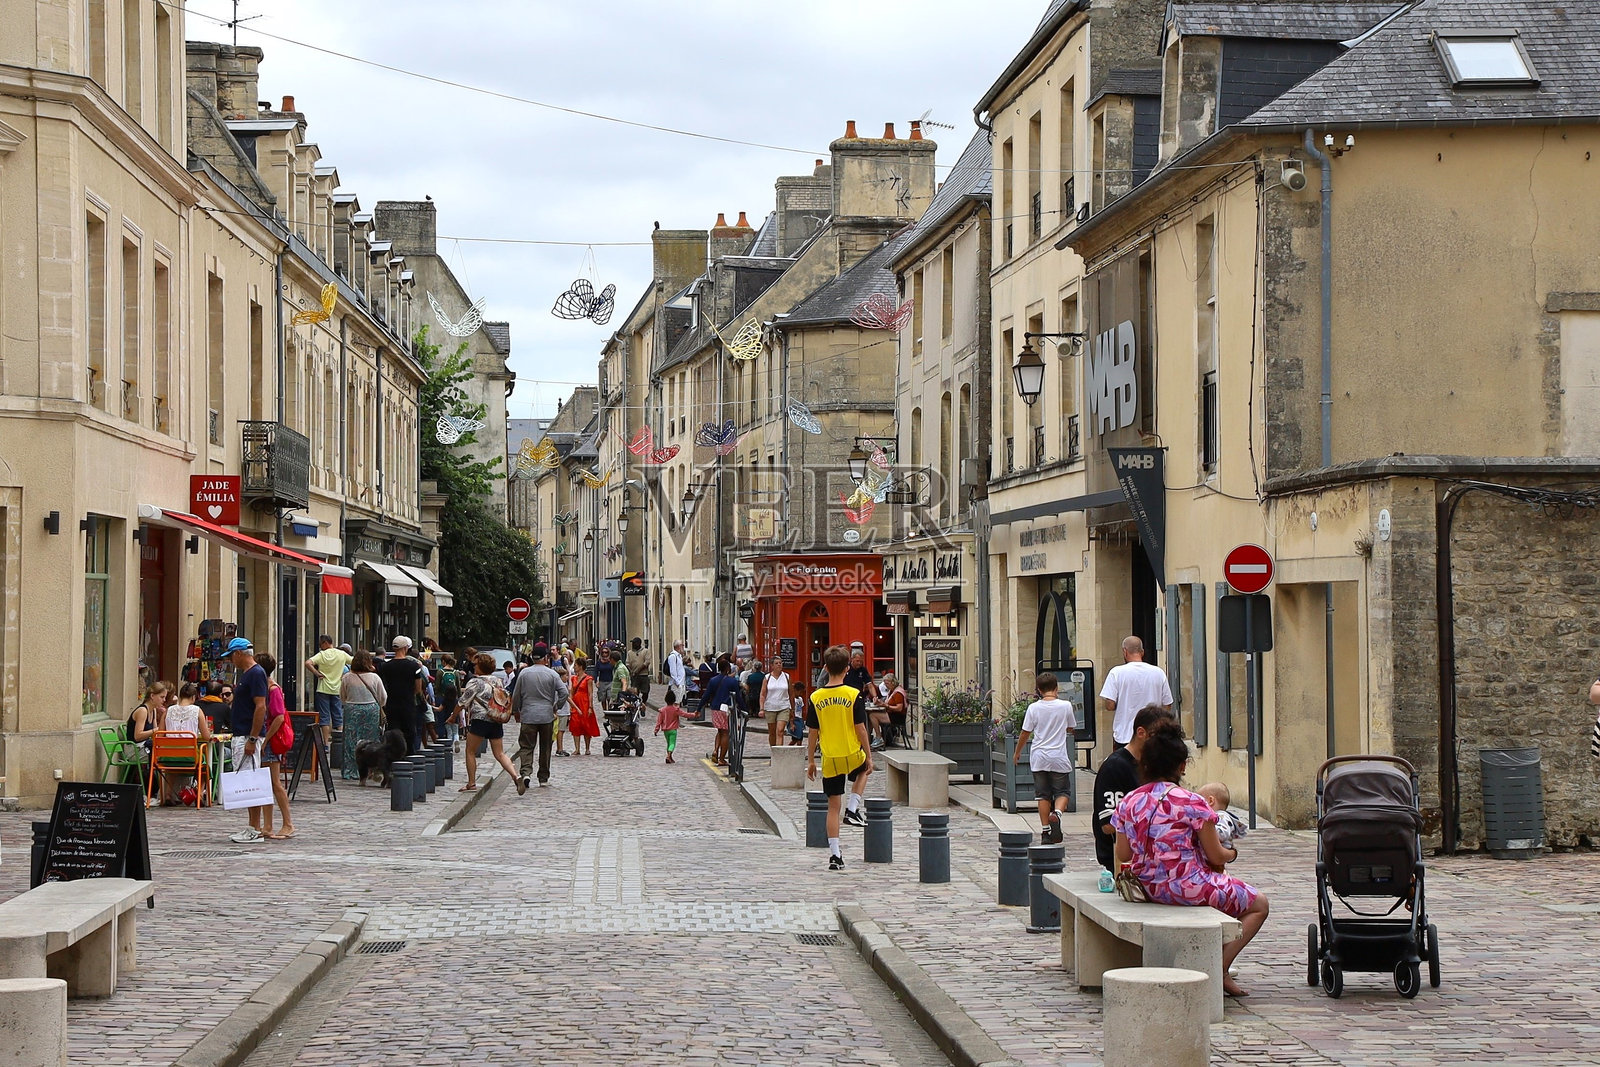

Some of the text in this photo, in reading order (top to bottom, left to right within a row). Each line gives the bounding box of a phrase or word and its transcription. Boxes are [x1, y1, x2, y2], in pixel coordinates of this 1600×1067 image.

[1084, 320, 1137, 440] MAHB
[1118, 454, 1155, 470] MAHB
[202, 481, 230, 490] JADE
[1120, 478, 1131, 499] BARON
[196, 491, 235, 502] ÉMILIA
[783, 566, 837, 574] Le Florentin
[816, 697, 853, 711] DORTMUND
[80, 789, 99, 798] Formule
